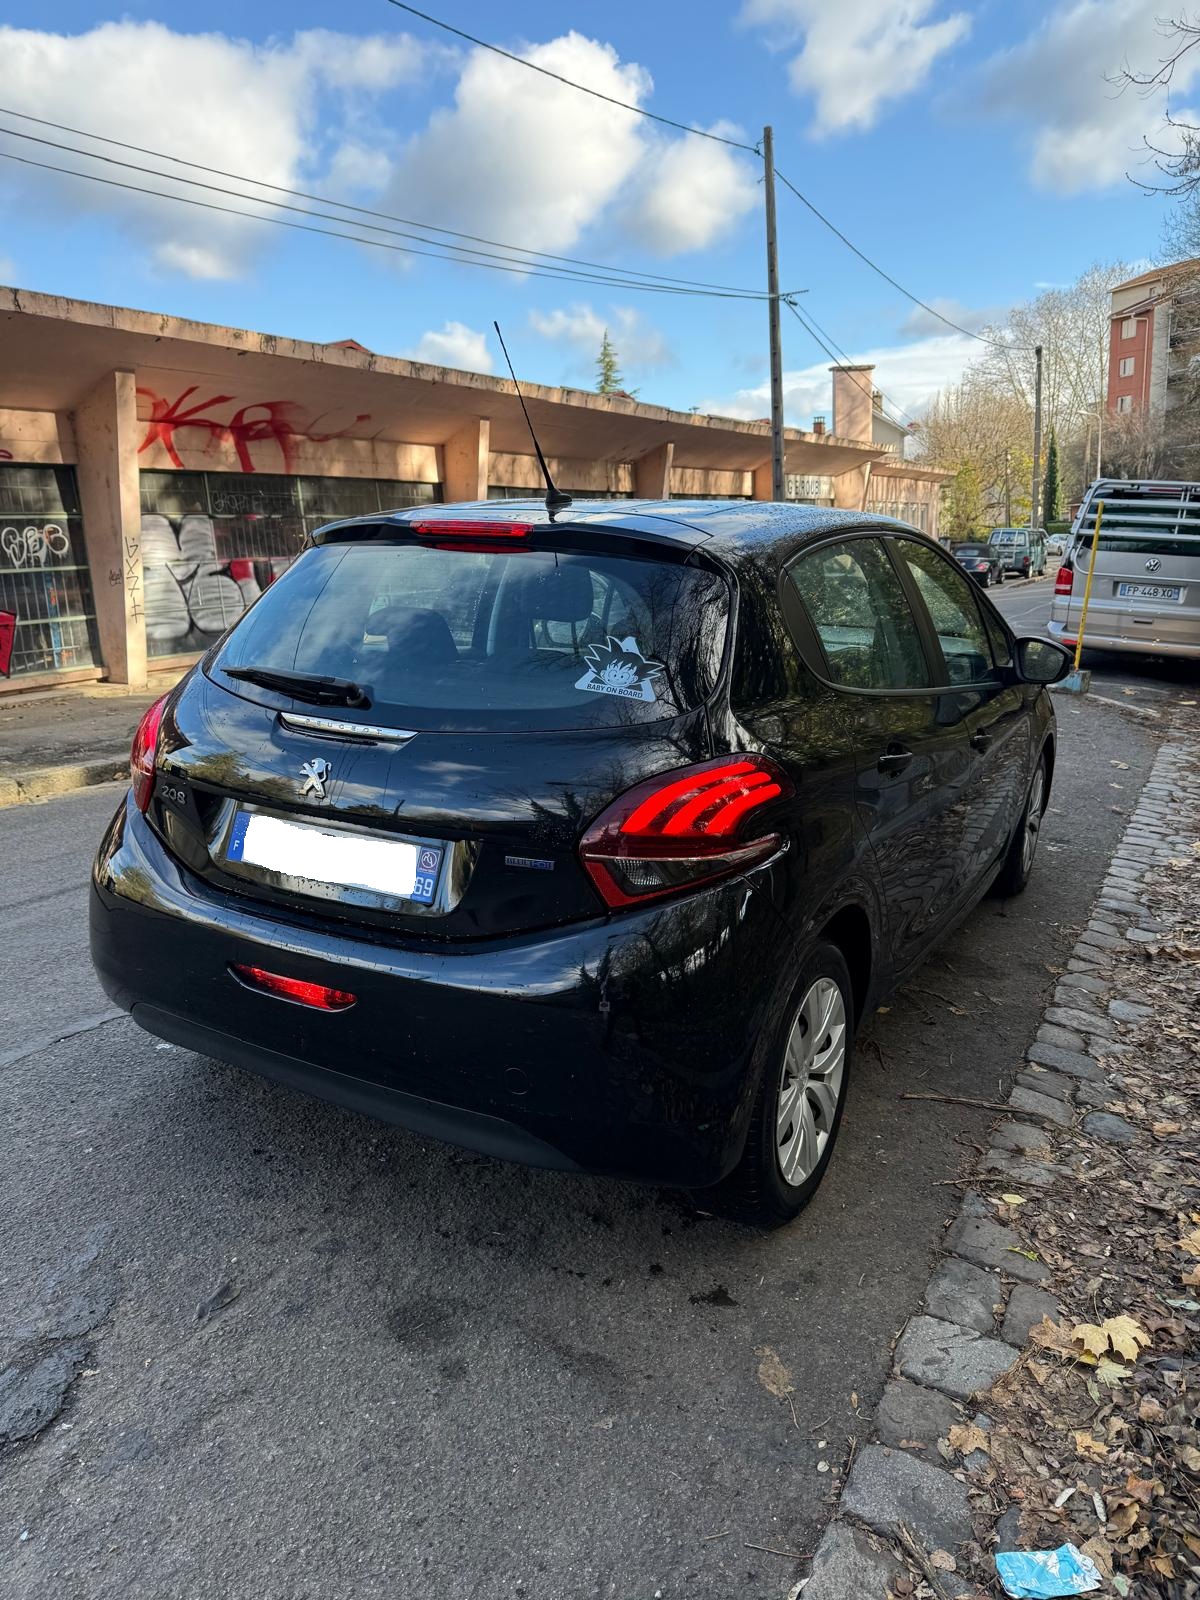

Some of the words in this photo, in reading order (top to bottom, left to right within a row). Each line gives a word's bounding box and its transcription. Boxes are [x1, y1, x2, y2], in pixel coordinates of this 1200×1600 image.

[586, 683, 605, 692] BABY
[606, 686, 617, 694] ON
[618, 689, 643, 699] BOARD
[304, 718, 383, 736] PEUGEOT
[161, 785, 186, 805] 208
[233, 840, 240, 851] F
[414, 876, 434, 897] 69
